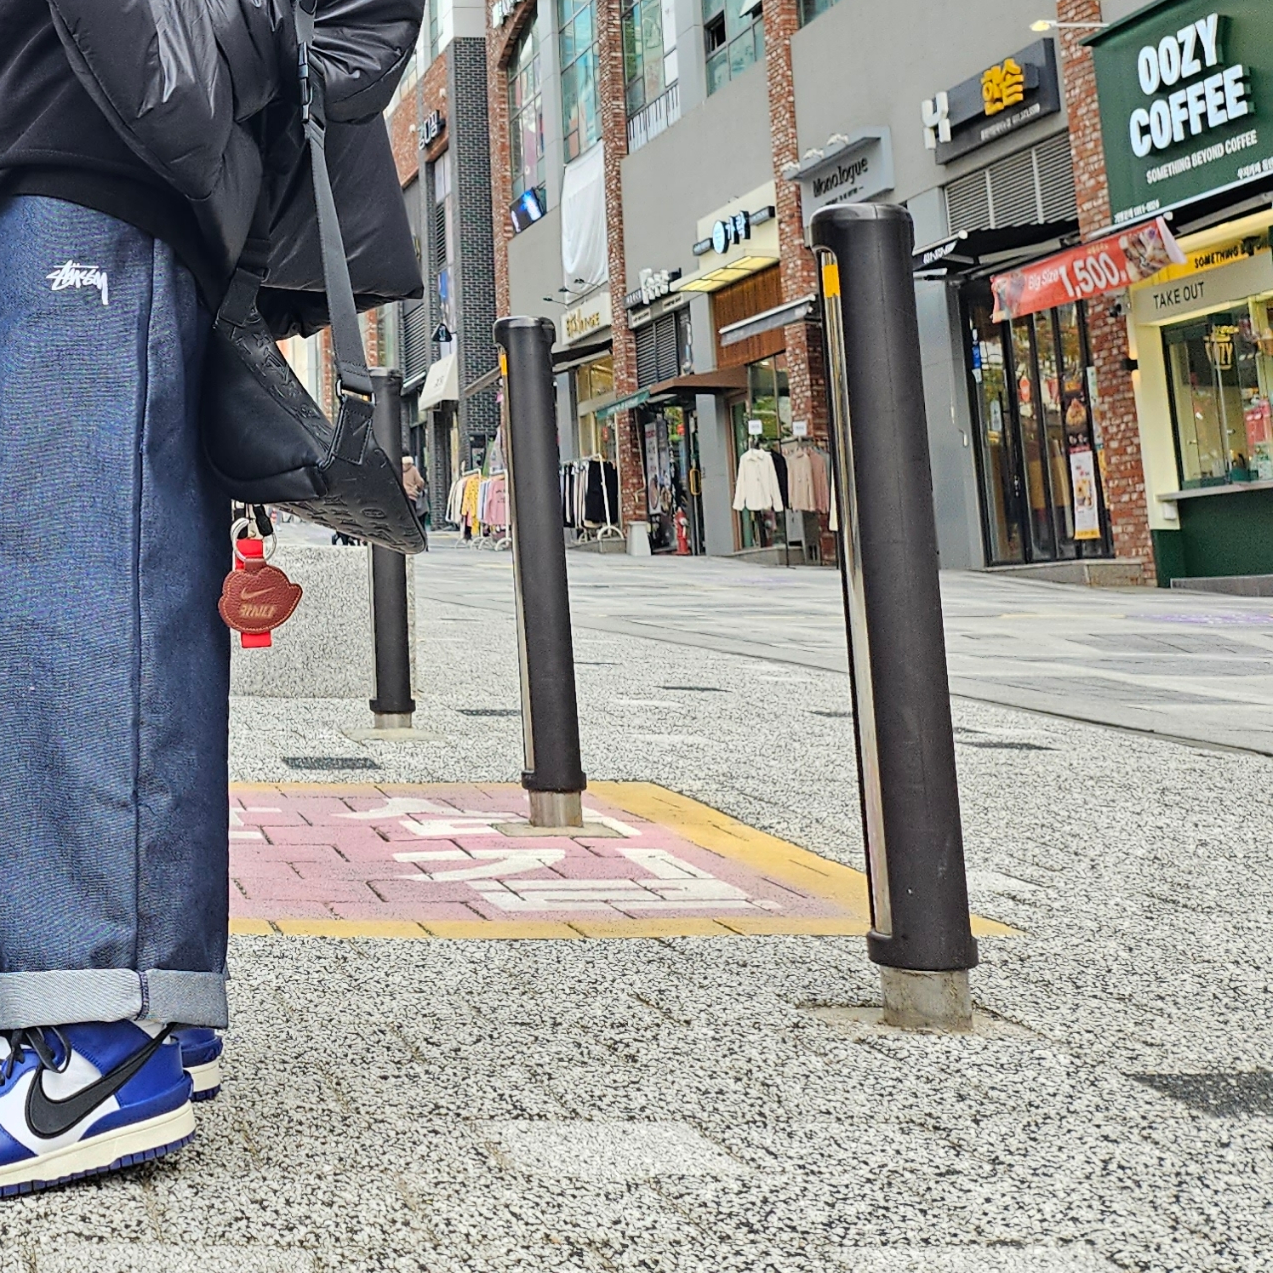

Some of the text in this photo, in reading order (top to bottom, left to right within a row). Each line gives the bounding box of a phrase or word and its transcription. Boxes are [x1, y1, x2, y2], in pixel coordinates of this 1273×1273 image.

[1138, 12, 1224, 96] OOZY
[1129, 64, 1250, 160] COFFEE
[812, 156, 869, 198] Monologue
[1146, 128, 1259, 185] SOMETHING BEYOND COFFEE
[1058, 250, 1120, 299] 1,500
[1194, 242, 1240, 270] SOMETHING
[1153, 280, 1206, 310] TAKE OUT
